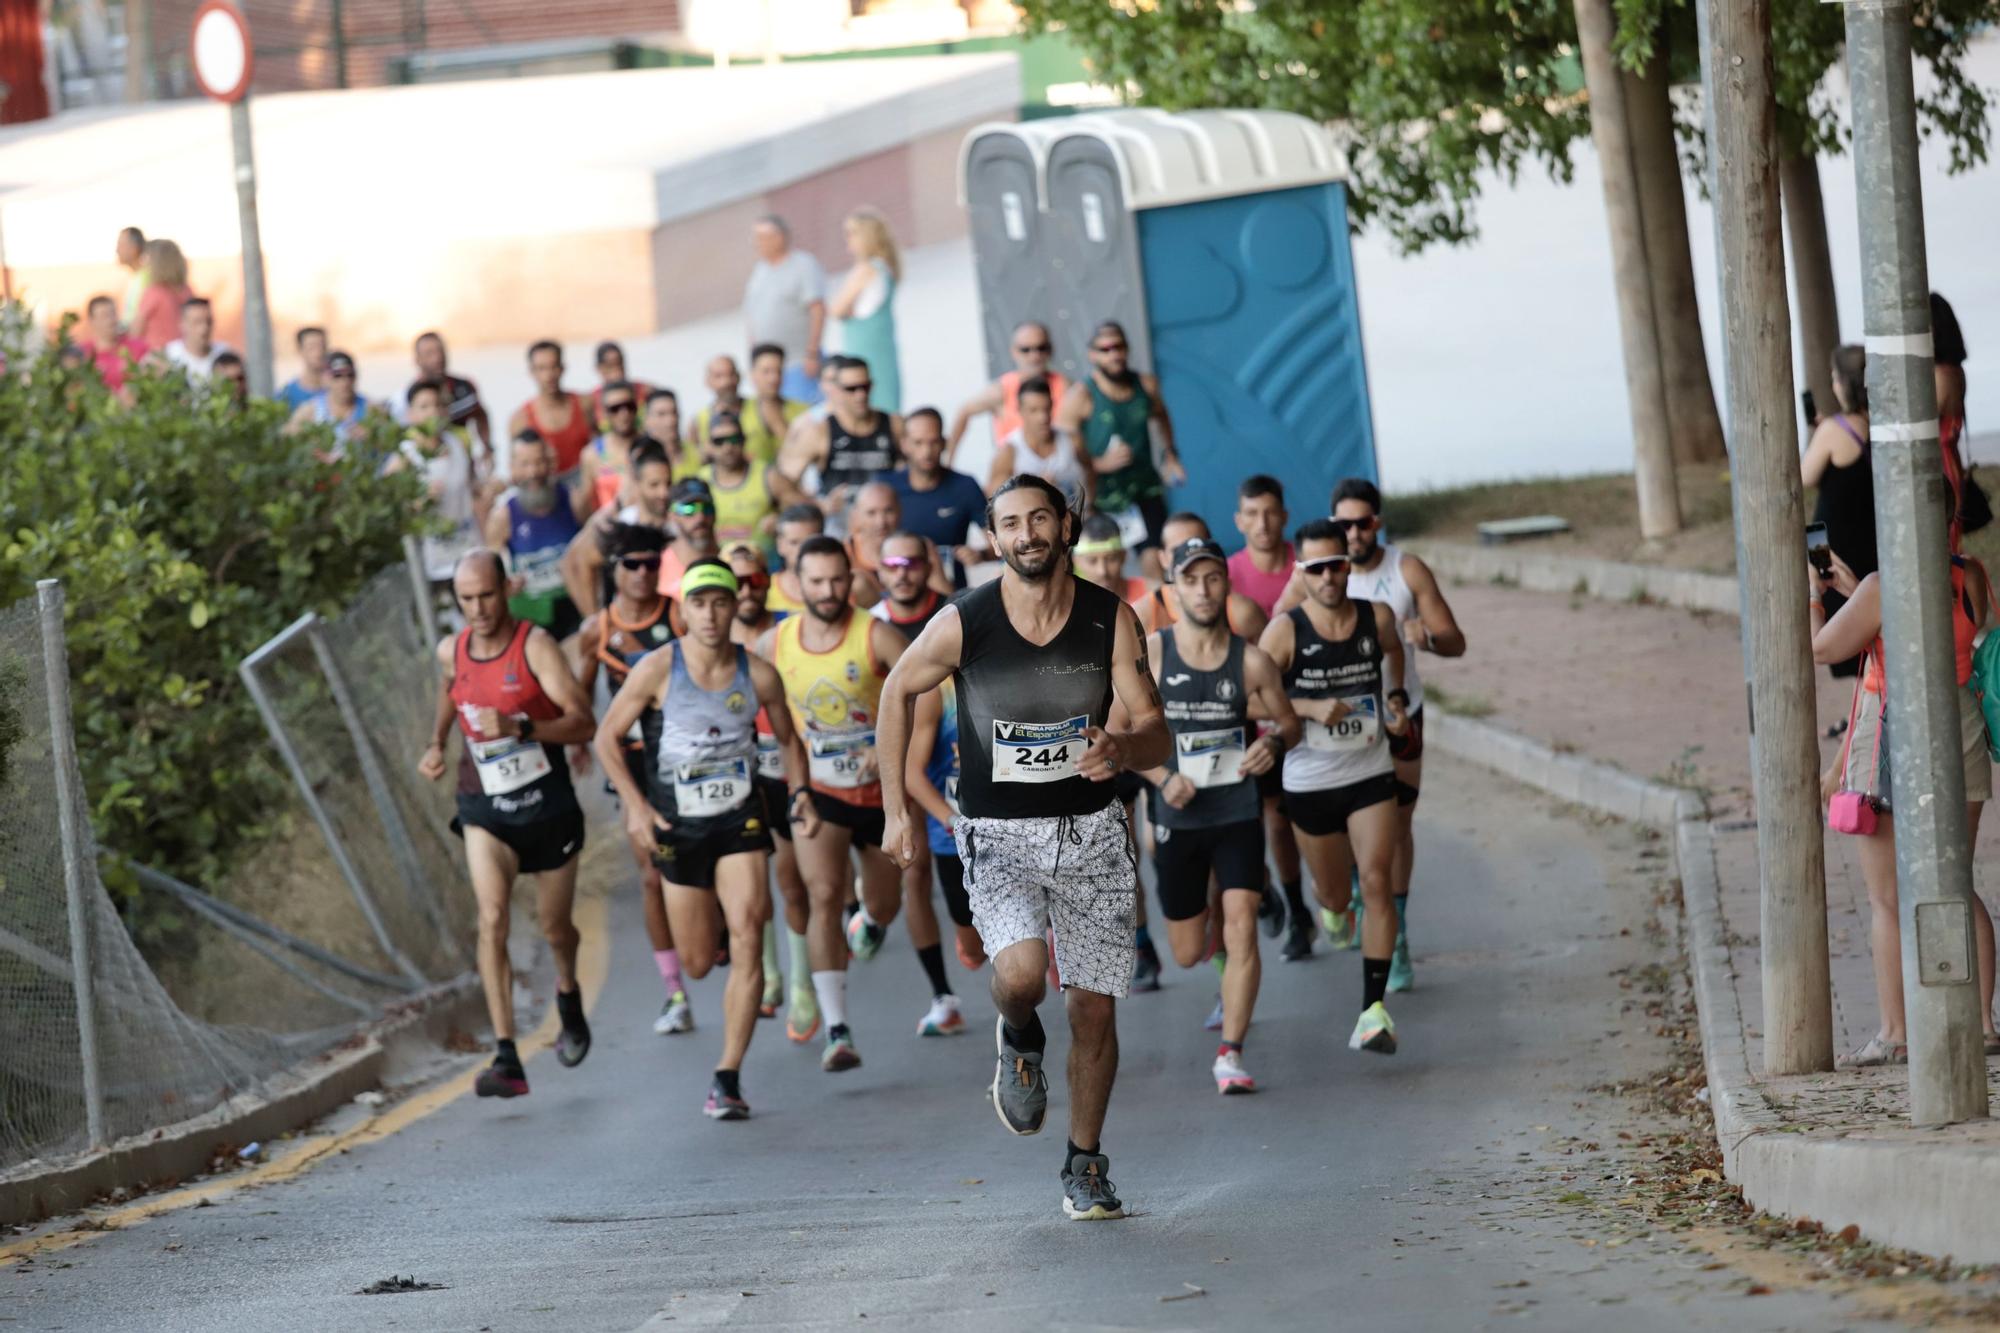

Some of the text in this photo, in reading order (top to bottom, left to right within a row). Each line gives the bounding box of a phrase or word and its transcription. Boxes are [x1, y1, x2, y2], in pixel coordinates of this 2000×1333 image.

[997, 723, 1014, 739] V
[1015, 722, 1070, 732] CARRERA POPULAR
[1016, 729, 1025, 737] El
[1016, 745, 1069, 766] 244
[1210, 753, 1221, 770] 7
[498, 758, 520, 776] 57
[833, 756, 859, 773] 96
[694, 782, 734, 799] 128
